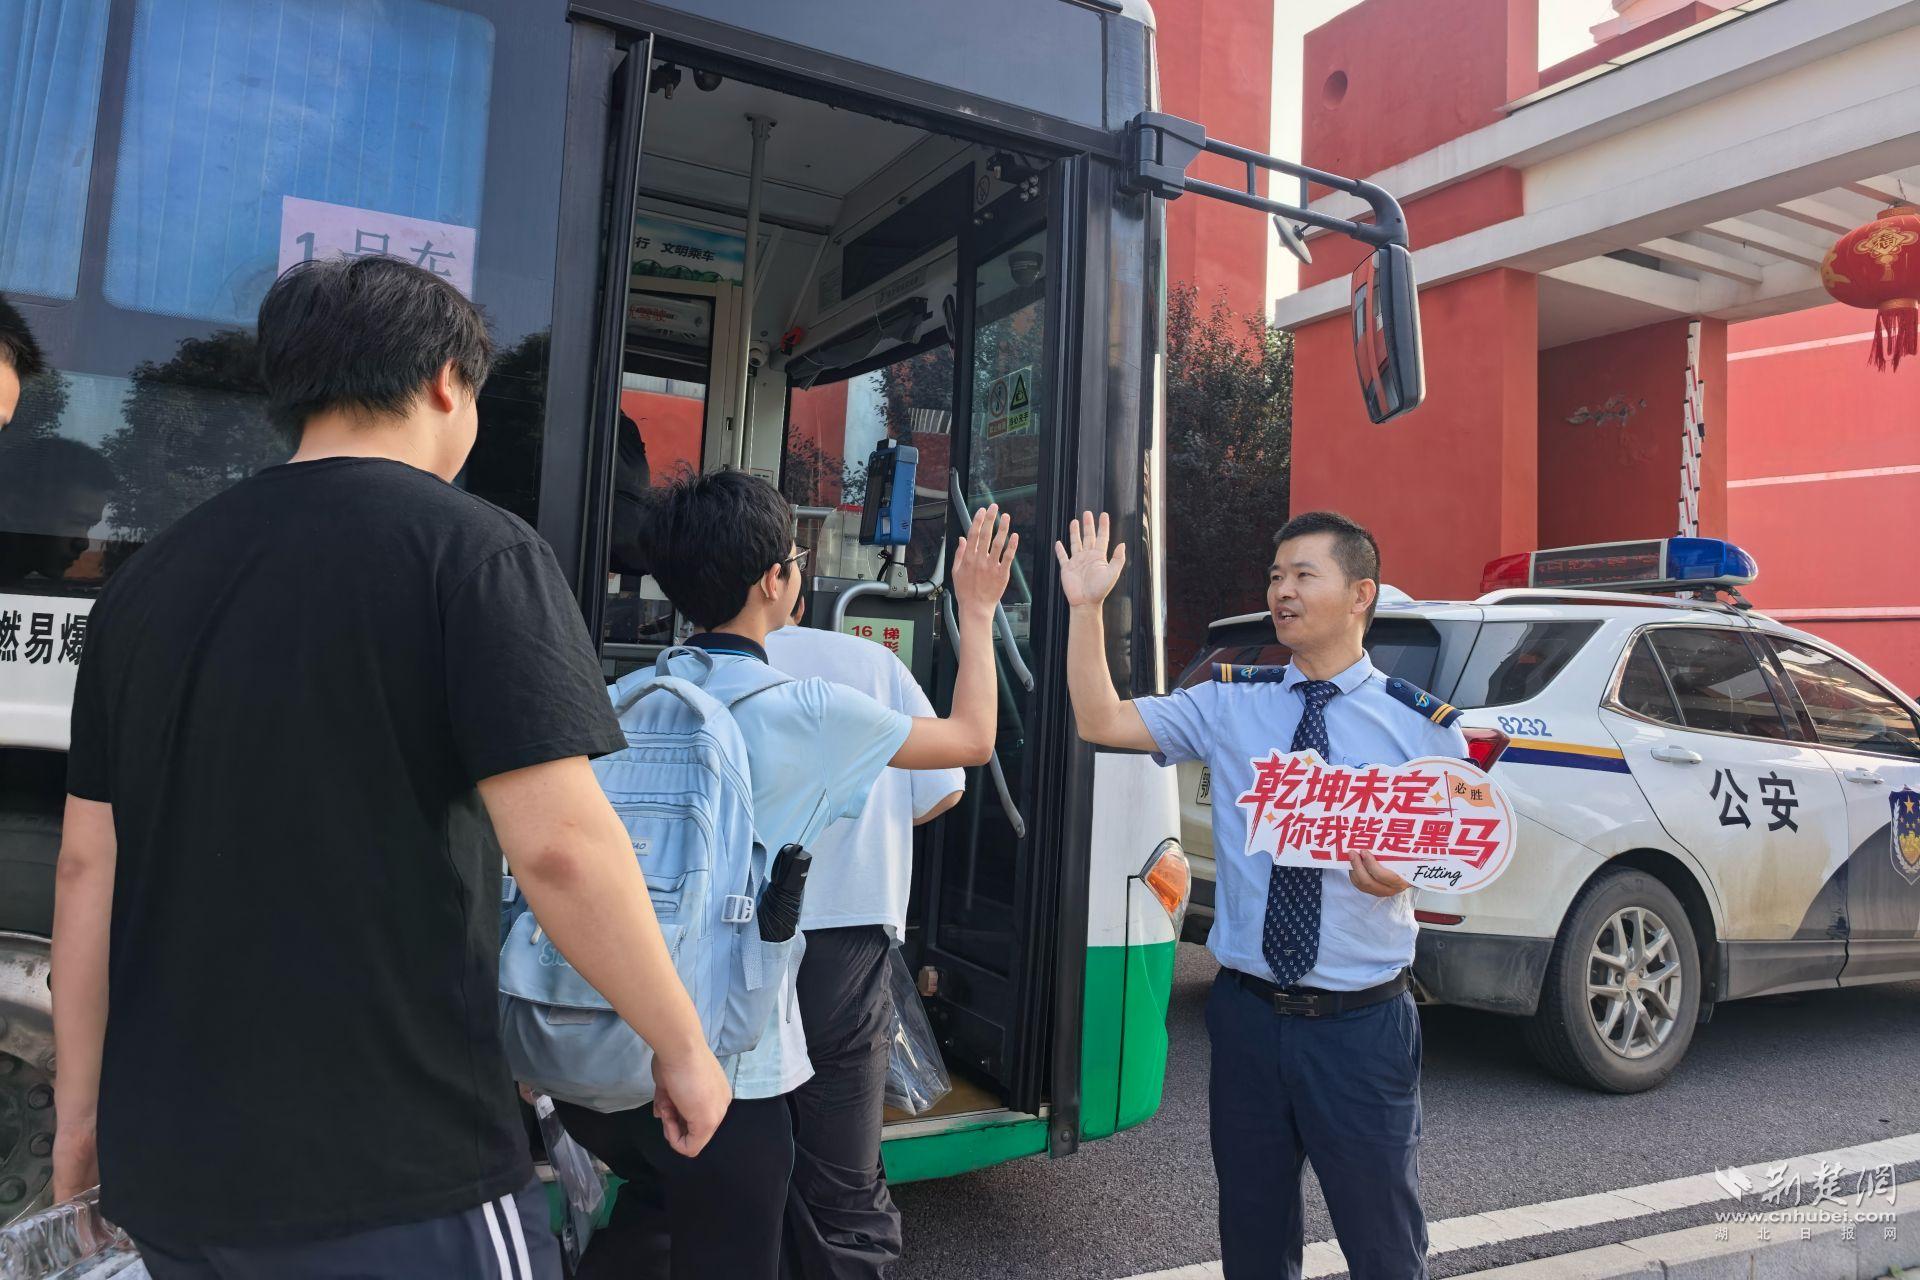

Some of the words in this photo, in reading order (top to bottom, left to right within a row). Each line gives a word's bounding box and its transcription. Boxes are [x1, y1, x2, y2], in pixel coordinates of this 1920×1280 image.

[661, 243, 716, 261] 文明乘车
[851, 626, 873, 638] 16
[1497, 716, 1552, 737] 8232
[1239, 752, 1456, 845] 乾坤未定
[1454, 782, 1484, 801] 必胜
[1709, 768, 1799, 834] 公安
[1272, 812, 1500, 868] 你我皆是黑马
[1413, 865, 1462, 887] Fitting
